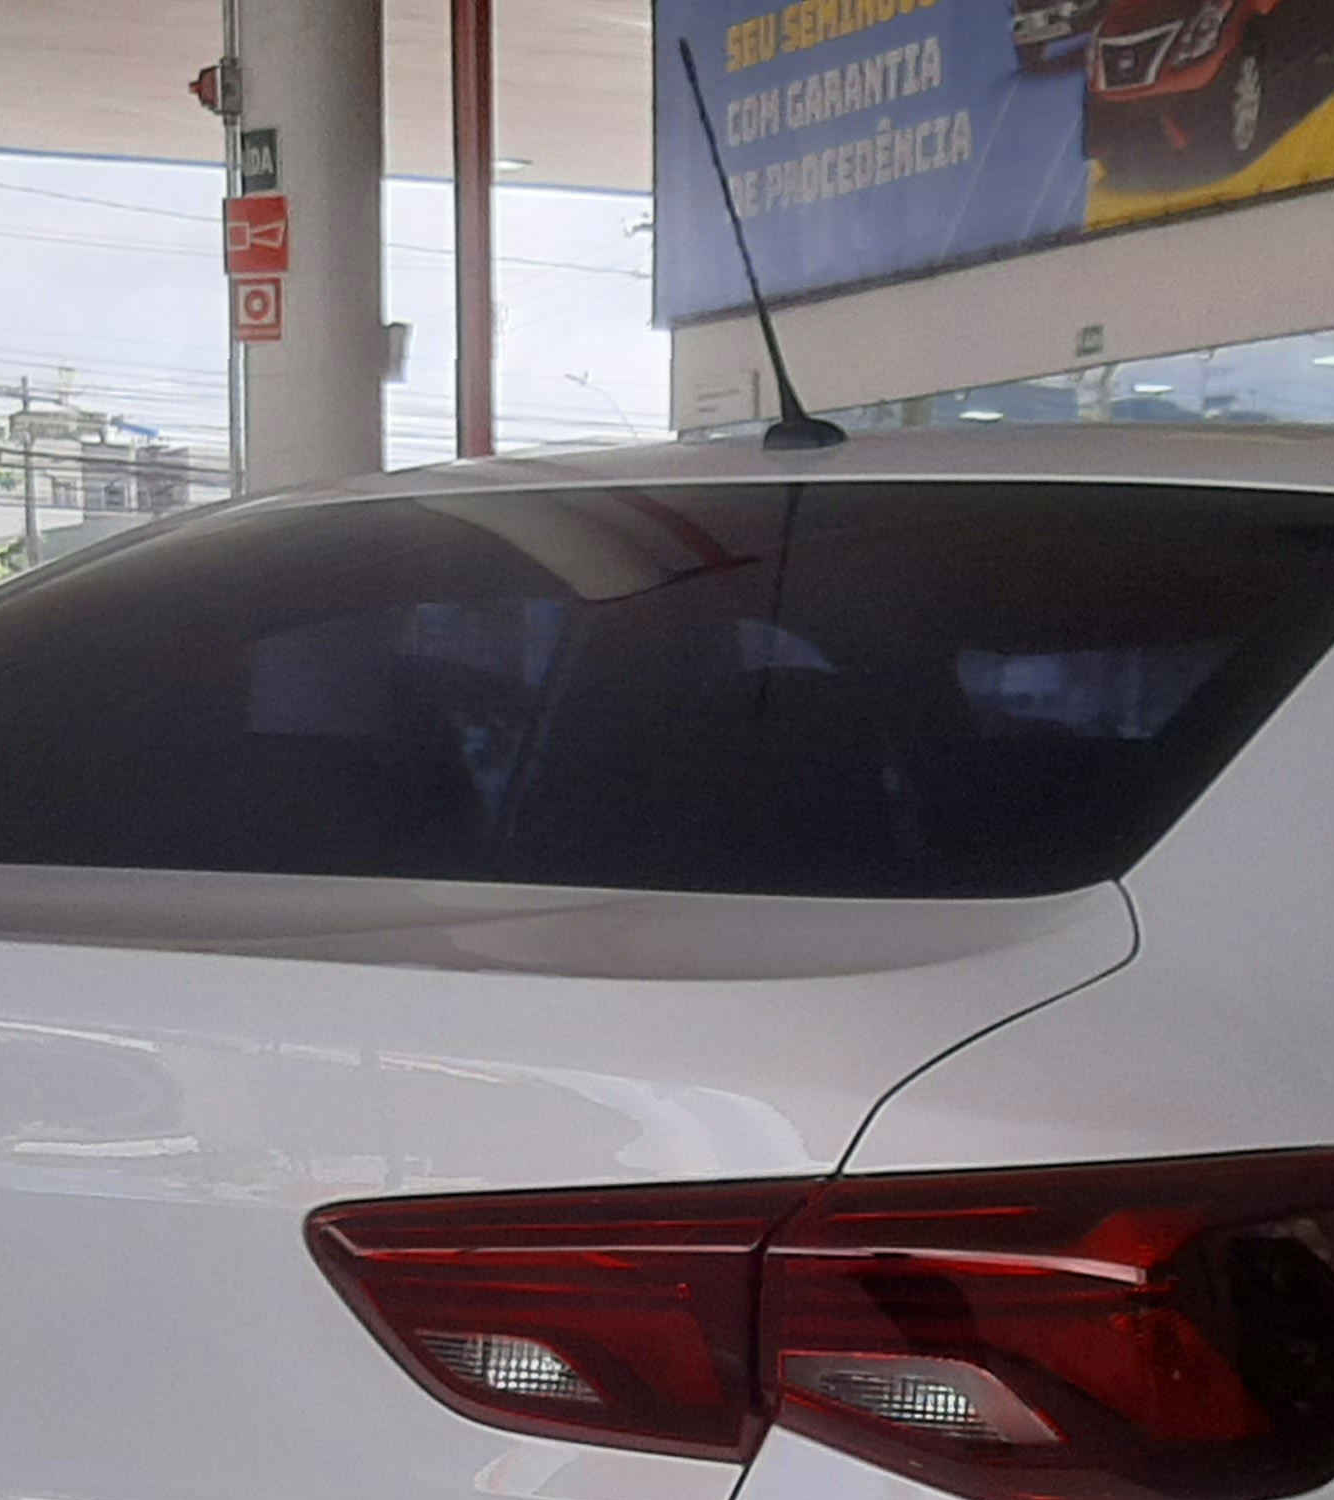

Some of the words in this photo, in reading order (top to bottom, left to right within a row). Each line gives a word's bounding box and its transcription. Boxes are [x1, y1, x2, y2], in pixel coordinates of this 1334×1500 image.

[726, 13, 778, 73] SEU
[727, 87, 780, 147] COM
[787, 37, 942, 130] GARANTIA
[729, 170, 759, 219] DE
[767, 110, 973, 212] PROCEDÊNCIA
